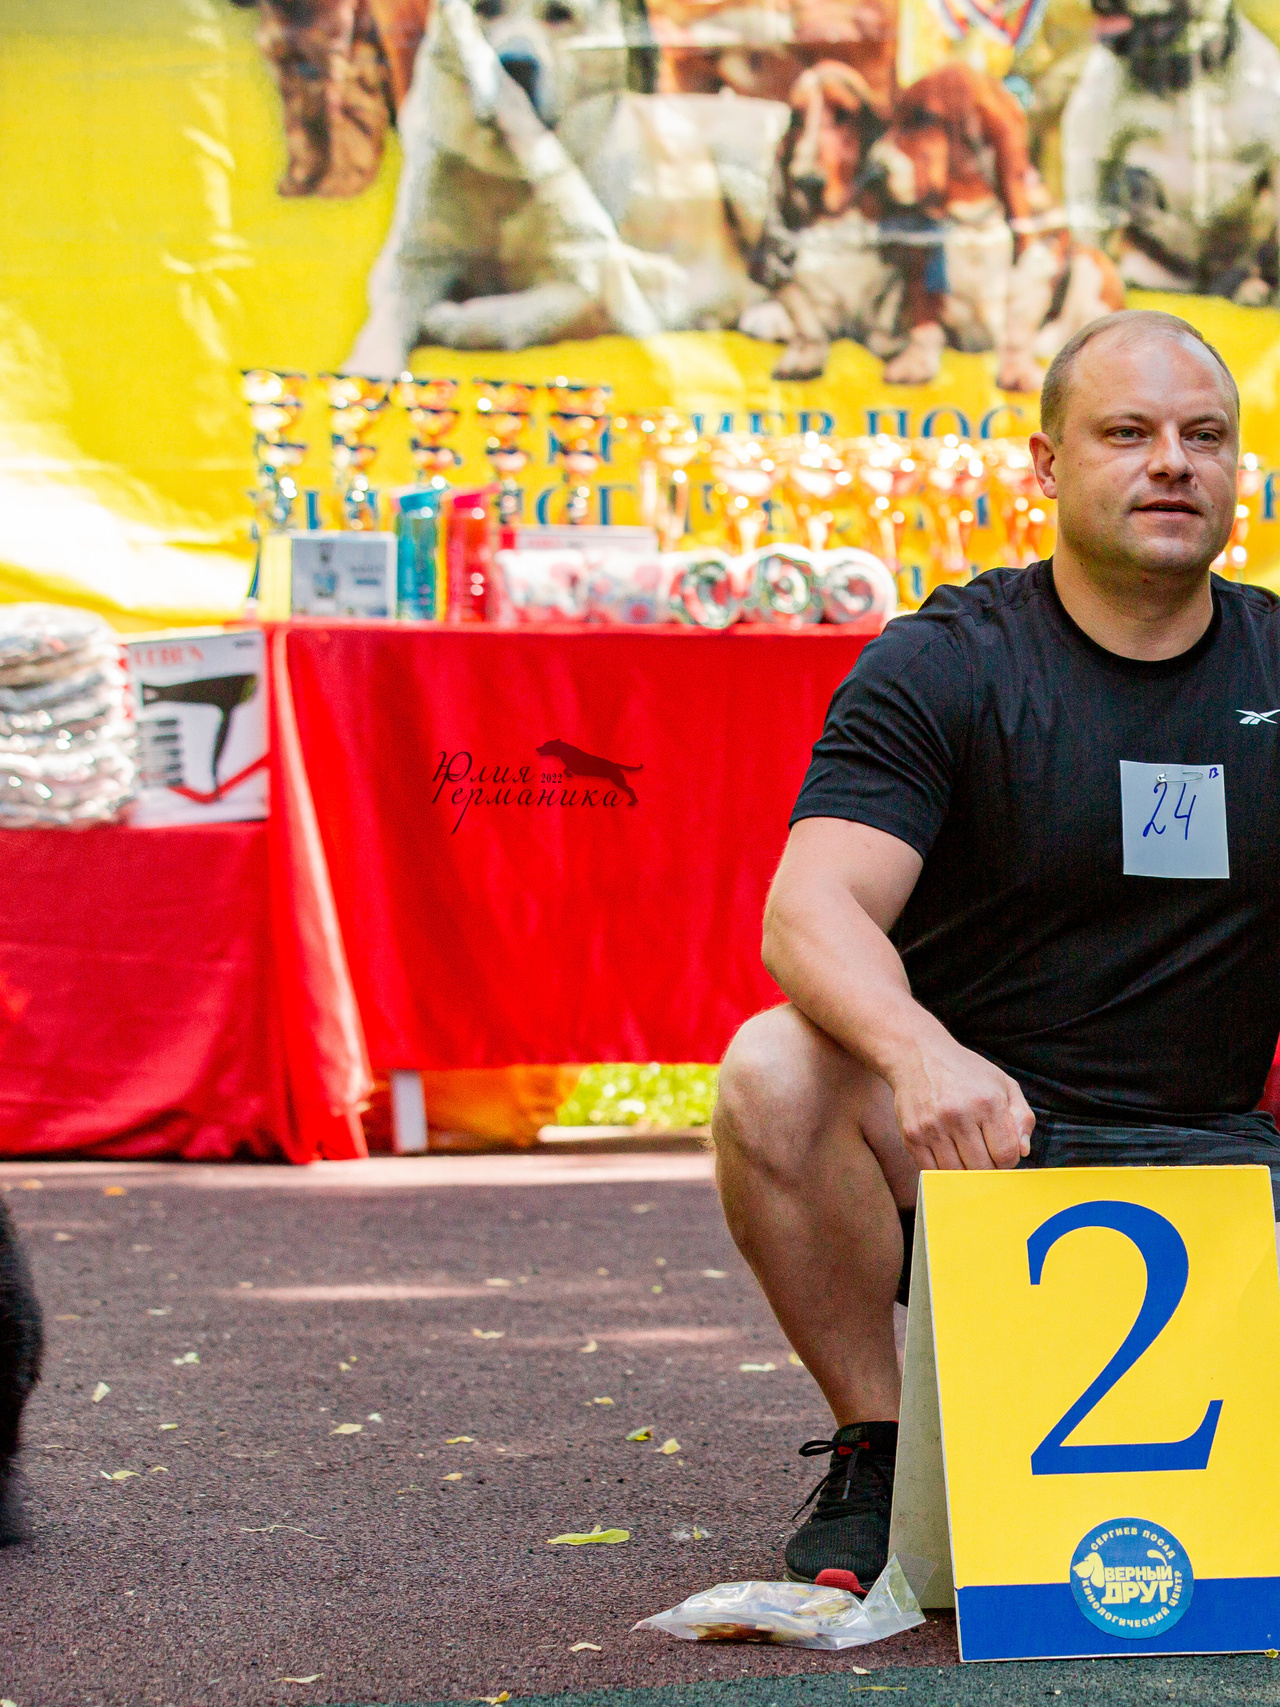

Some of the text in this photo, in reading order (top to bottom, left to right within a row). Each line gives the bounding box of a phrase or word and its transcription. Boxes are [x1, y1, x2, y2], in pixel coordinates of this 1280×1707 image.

[1142, 781, 1197, 841] 24
[1026, 1200, 1224, 1475] 2
[1090, 1527, 1176, 1559] СЕРГИЕВ ПОСАД
[1082, 1570, 1183, 1628] КИНОЛОГИЧЕСКИЙ ЦЕНТР
[1101, 1580, 1174, 1604] ДРУГ
